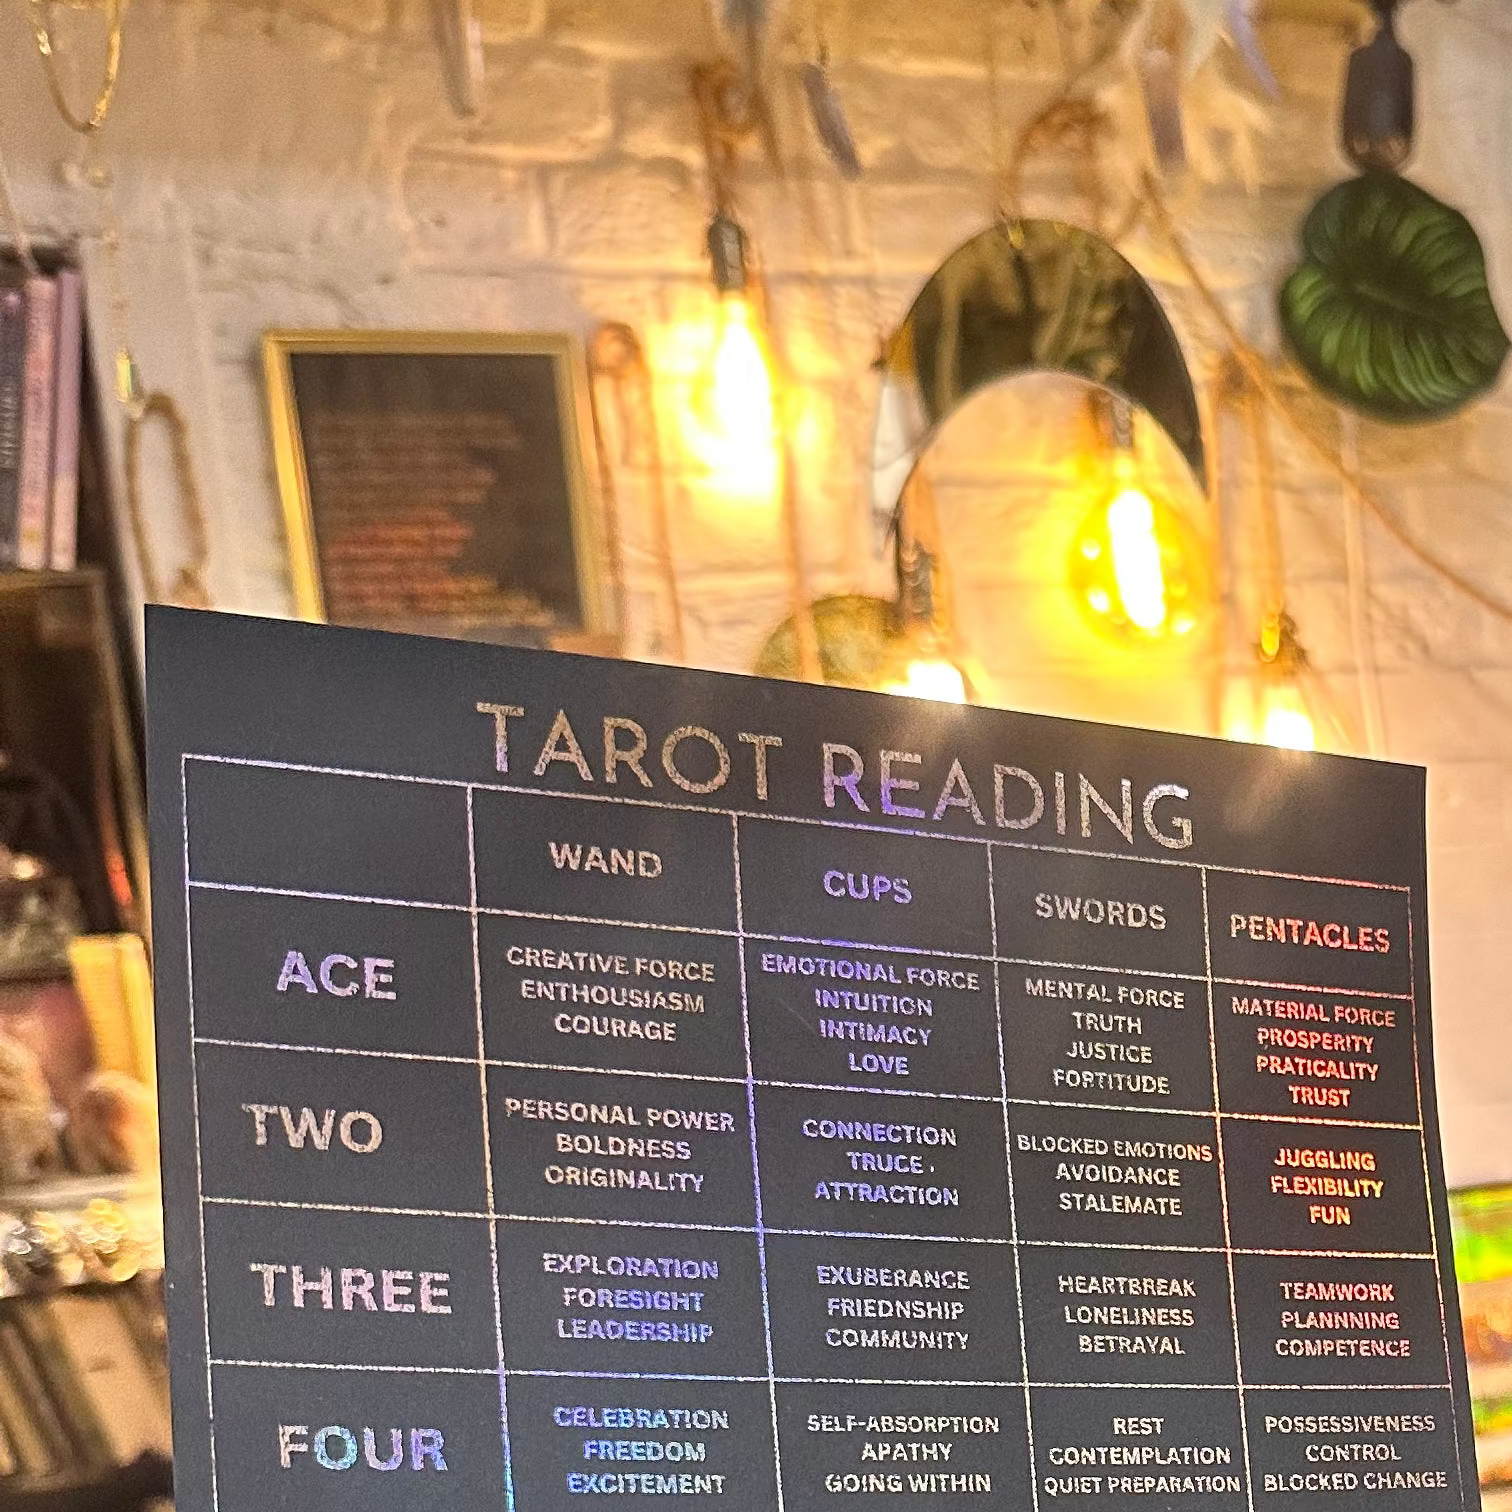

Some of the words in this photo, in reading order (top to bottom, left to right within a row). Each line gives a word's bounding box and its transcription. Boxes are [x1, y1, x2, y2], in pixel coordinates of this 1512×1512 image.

[475, 701, 782, 800] TAROT
[822, 742, 1192, 848] READING
[548, 841, 661, 877] WAND
[823, 869, 911, 903] CUPS
[1035, 893, 1165, 929] SWORDS
[1230, 914, 1389, 952] PENTACLES
[276, 950, 395, 999] ACE
[553, 1013, 675, 1041] COURAGE
[1071, 1011, 1141, 1034] TRUTH
[848, 1052, 908, 1074] LOVE
[1288, 1084, 1349, 1106] TRUST
[504, 1097, 640, 1124] PERSONAL
[646, 1108, 734, 1131] POWER
[241, 1103, 382, 1152] TWO
[1055, 1162, 1180, 1185] AVOIDANCE
[814, 1181, 958, 1205] ATTRACTION
[1309, 1204, 1350, 1224] FUN
[542, 1252, 718, 1278] EXPLORATION
[249, 1263, 451, 1313] THREE
[1279, 1282, 1394, 1300] TEAMWORK
[827, 1297, 963, 1319] FRIEDNSHIP
[1064, 1305, 1194, 1325] LONELINESS
[1264, 1415, 1435, 1432] POSSESSIVENESS
[278, 1425, 447, 1470] FOUR
[861, 1442, 952, 1460] APATHY
[1049, 1446, 1230, 1464] CONTEMPLATION
[566, 1471, 724, 1493] EXCITEMENT
